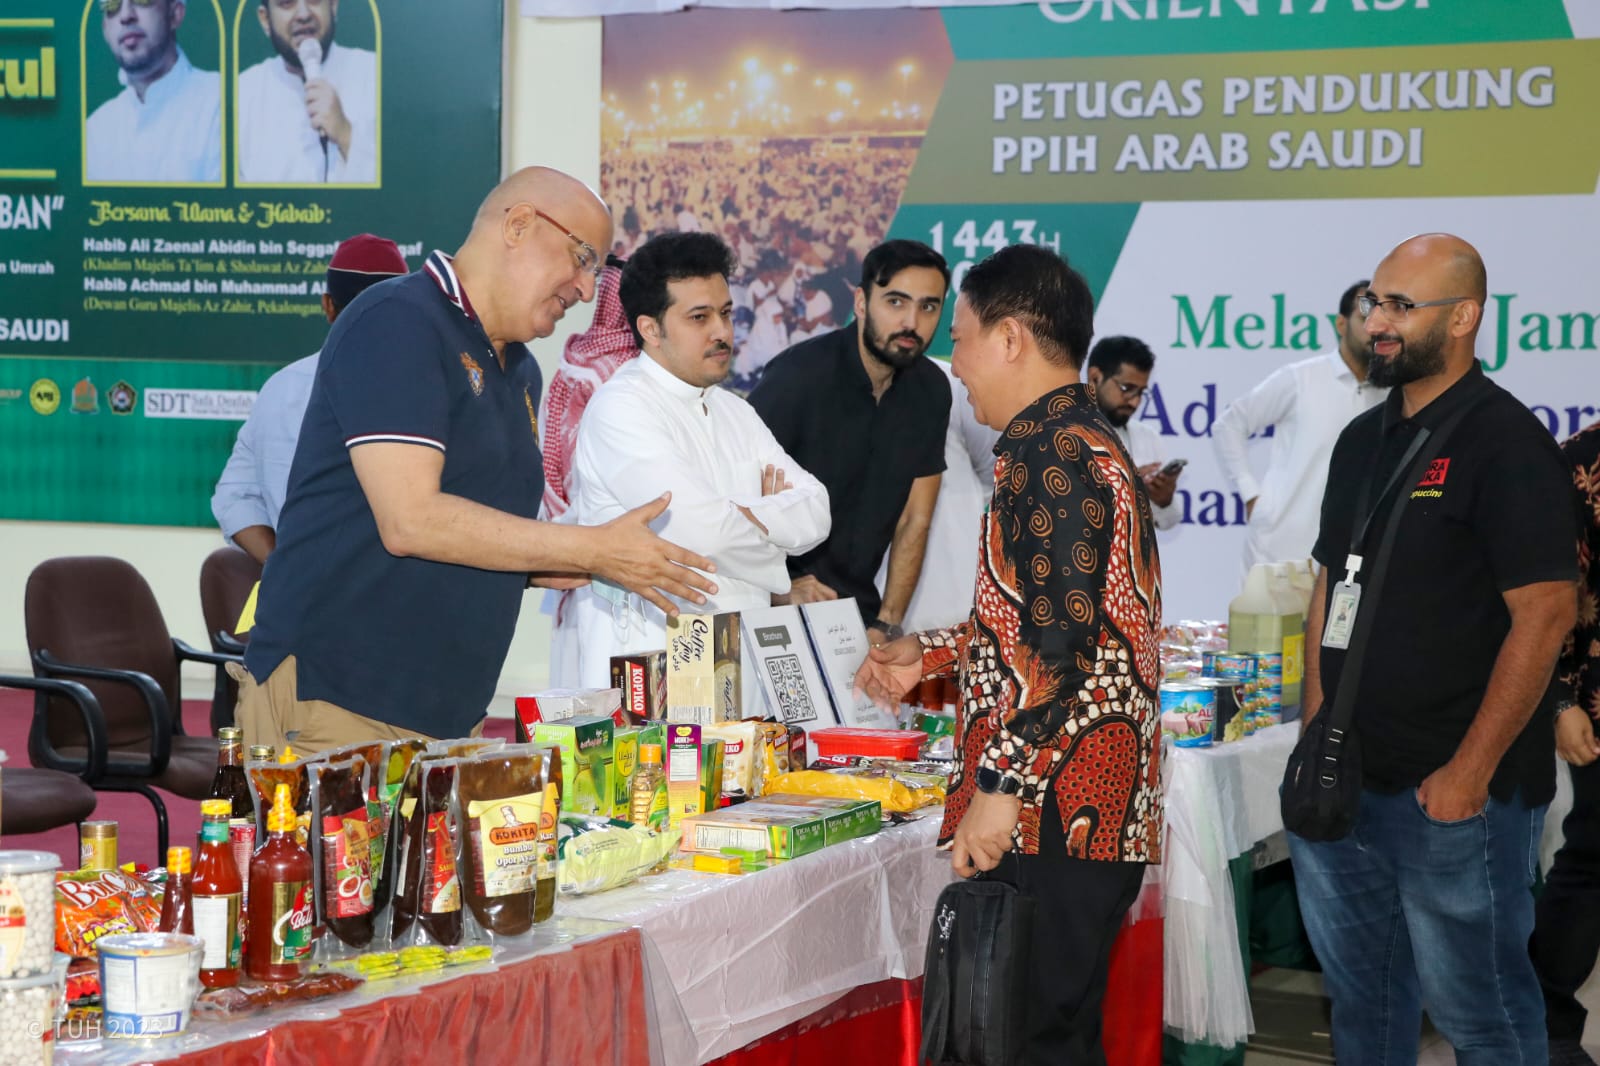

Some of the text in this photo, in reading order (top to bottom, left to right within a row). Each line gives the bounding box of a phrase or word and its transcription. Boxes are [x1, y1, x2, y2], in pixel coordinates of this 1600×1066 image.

[992, 66, 1555, 122] PETUGAS PENDUKUNG
[992, 128, 1425, 174] PPIH ARAB SAUDI
[89, 200, 171, 226] Bersama
[173, 201, 236, 223] Ulama
[238, 202, 254, 224] &
[83, 238, 127, 251] Habib
[130, 238, 150, 252] Ali
[154, 239, 205, 253] Zaenal
[208, 239, 256, 254] Abidin
[259, 240, 283, 255] bin
[10, 260, 55, 275] Umrah
[135, 258, 175, 274] Majelis
[216, 261, 227, 273] &
[285, 261, 300, 273] Az
[83, 277, 127, 291] Habib
[130, 278, 191, 292] Achmad
[194, 279, 218, 293] bin
[221, 279, 308, 295] Muhammad
[83, 297, 127, 312] (Dewan
[129, 298, 157, 311] Guru
[159, 298, 201, 315] Majelis
[202, 300, 219, 313] Az
[0, 319, 69, 342] SAUDI
[147, 393, 190, 413] SDT
[692, 618, 708, 662] Coffee
[632, 667, 645, 712] KOPIKO
[495, 827, 536, 841] KOKITA
[503, 843, 533, 855] Bumbu
[496, 857, 518, 867] Opor
